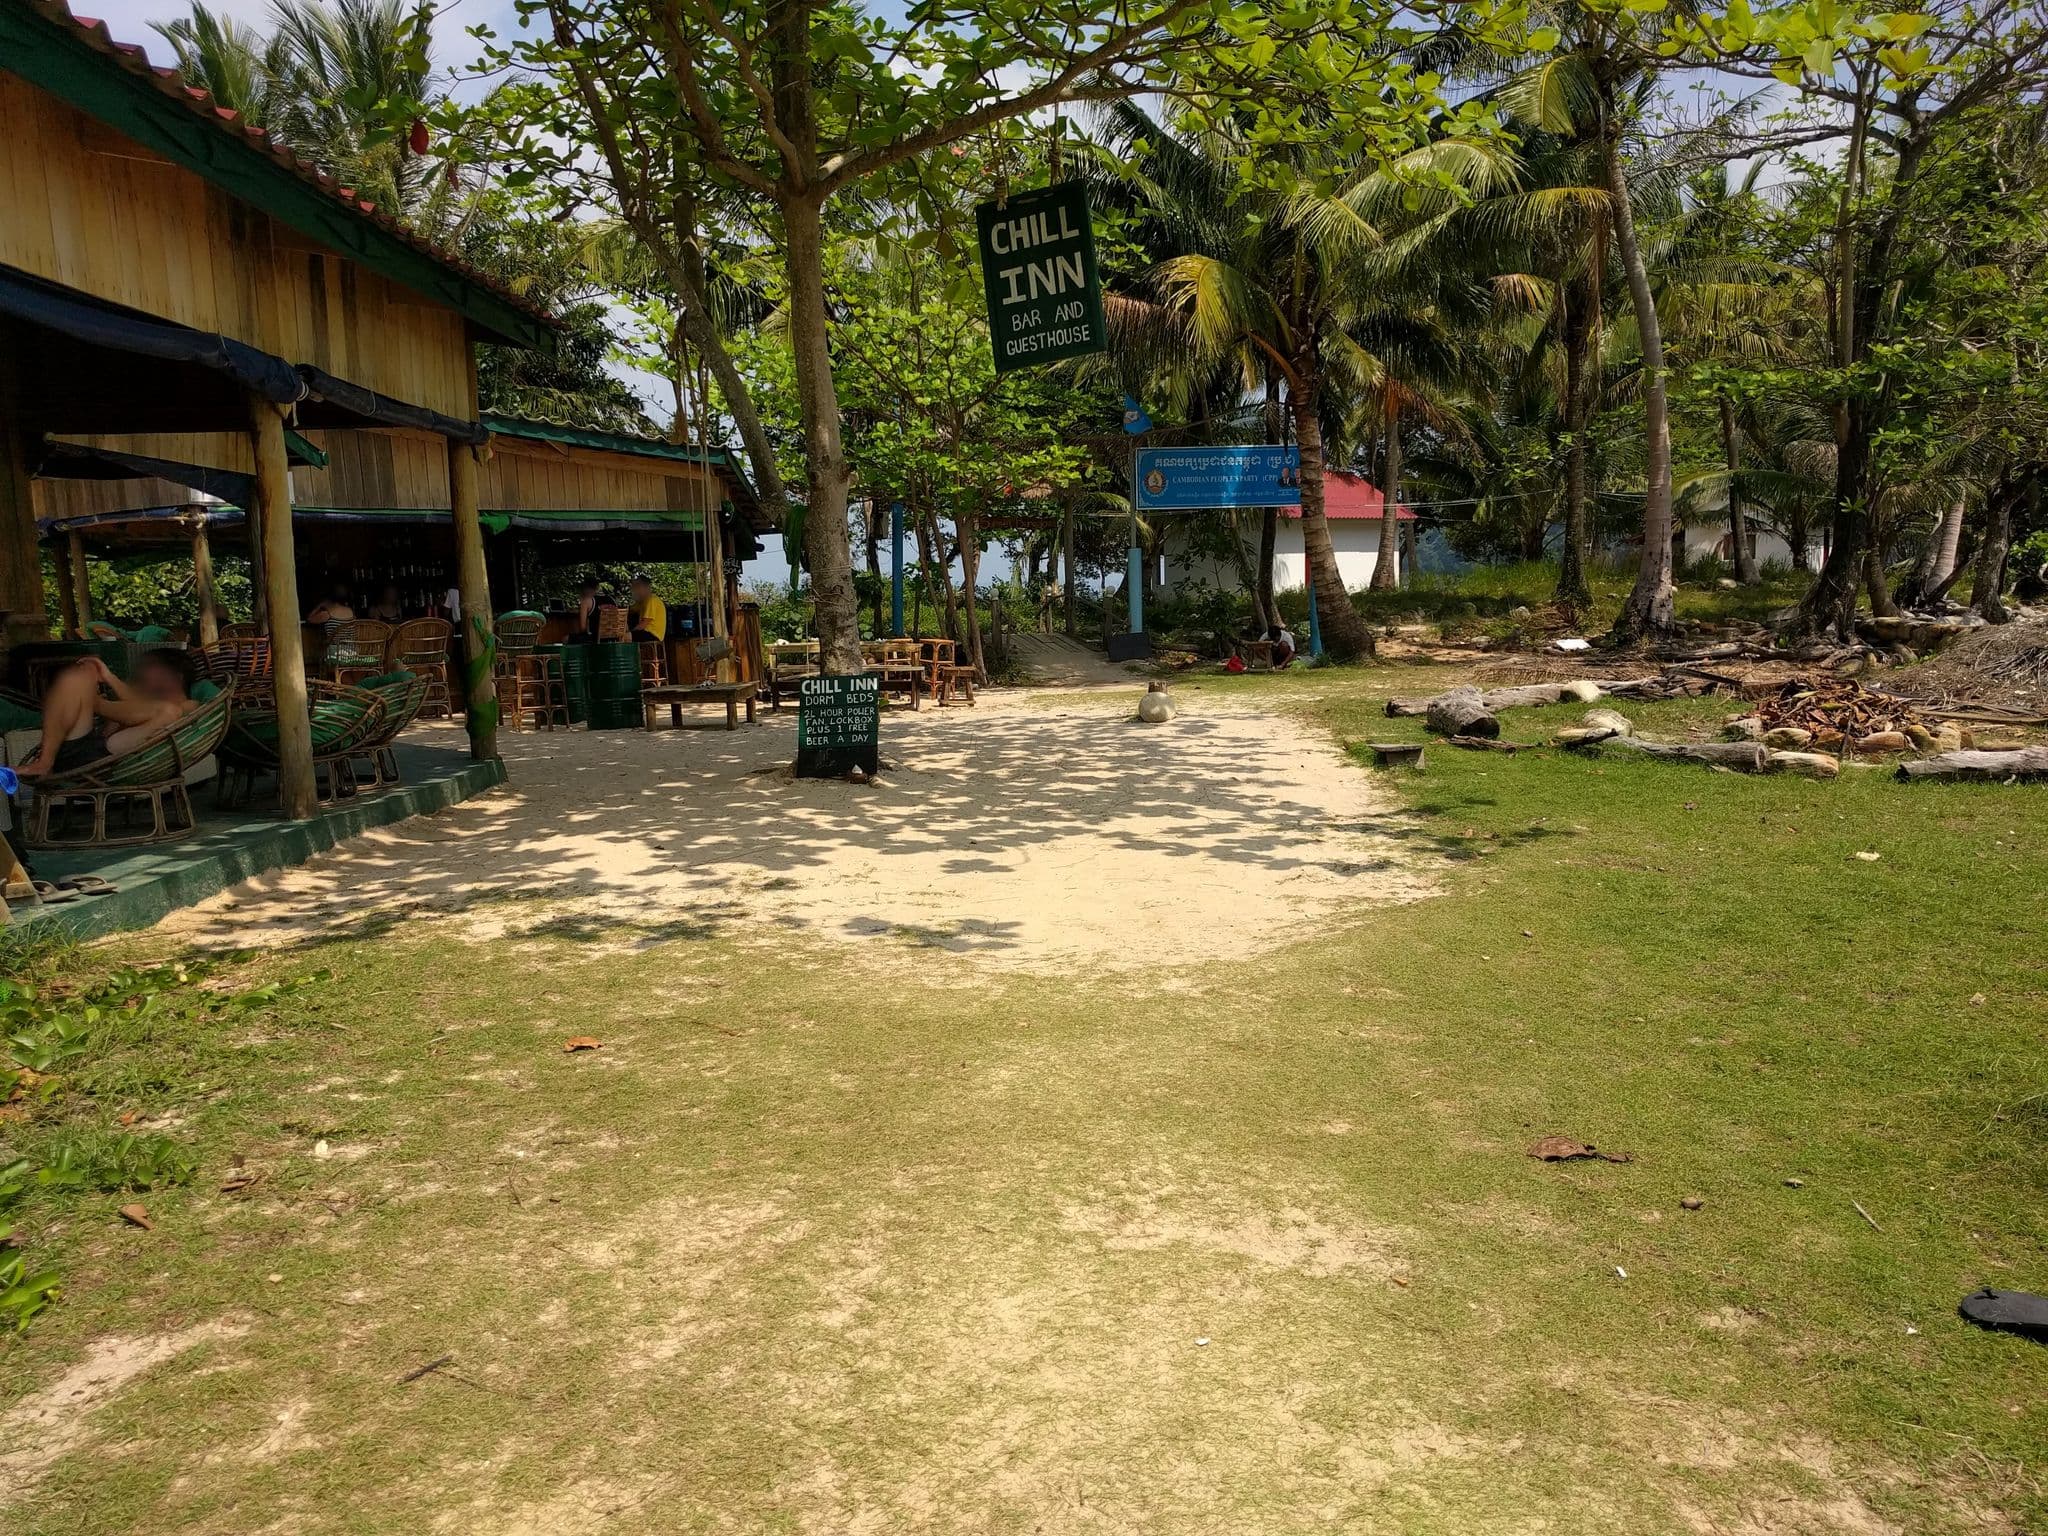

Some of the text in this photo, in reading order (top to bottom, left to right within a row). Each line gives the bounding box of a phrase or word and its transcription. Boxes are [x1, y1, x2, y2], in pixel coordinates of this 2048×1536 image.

[991, 206, 1079, 255] CHILL
[1000, 251, 1085, 305] INN
[1012, 301, 1084, 332] BAR AND
[1006, 324, 1090, 356] GUESTHOUSE
[1172, 475, 1210, 484] CAMBODIAN
[1239, 474, 1258, 482] PARTY
[801, 677, 878, 695] CHILL INN
[805, 692, 874, 706] DORM BEDS
[820, 708, 844, 718] HOUR
[847, 706, 875, 716] POWER
[805, 716, 873, 727] FAN LOCKBOX
[806, 723, 868, 735] PLUS 1 FREE
[806, 734, 869, 746] BEER A DAY
